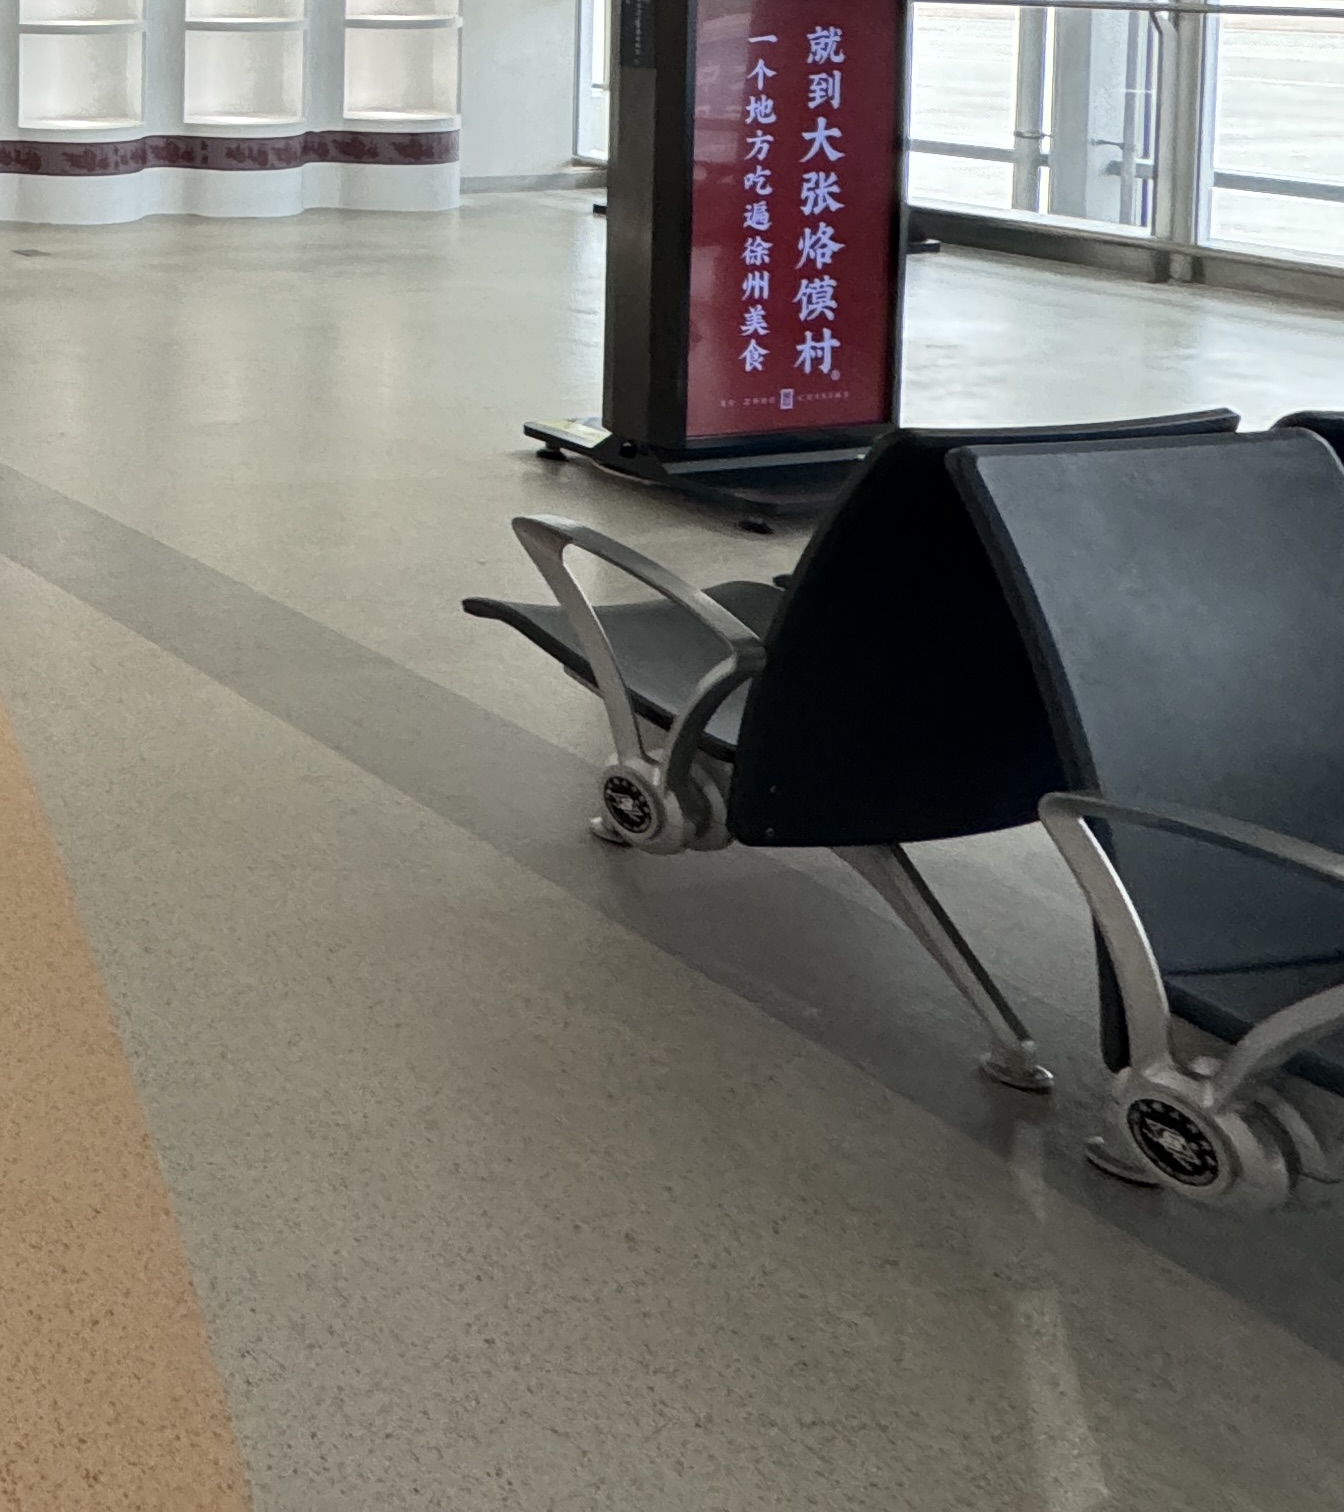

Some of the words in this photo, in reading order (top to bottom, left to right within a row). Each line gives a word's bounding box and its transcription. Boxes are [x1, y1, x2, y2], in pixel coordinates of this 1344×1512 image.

[739, 34, 779, 372] 一个地方吃遍徐州美食
[792, 26, 847, 375] 就到大张烙馍村
